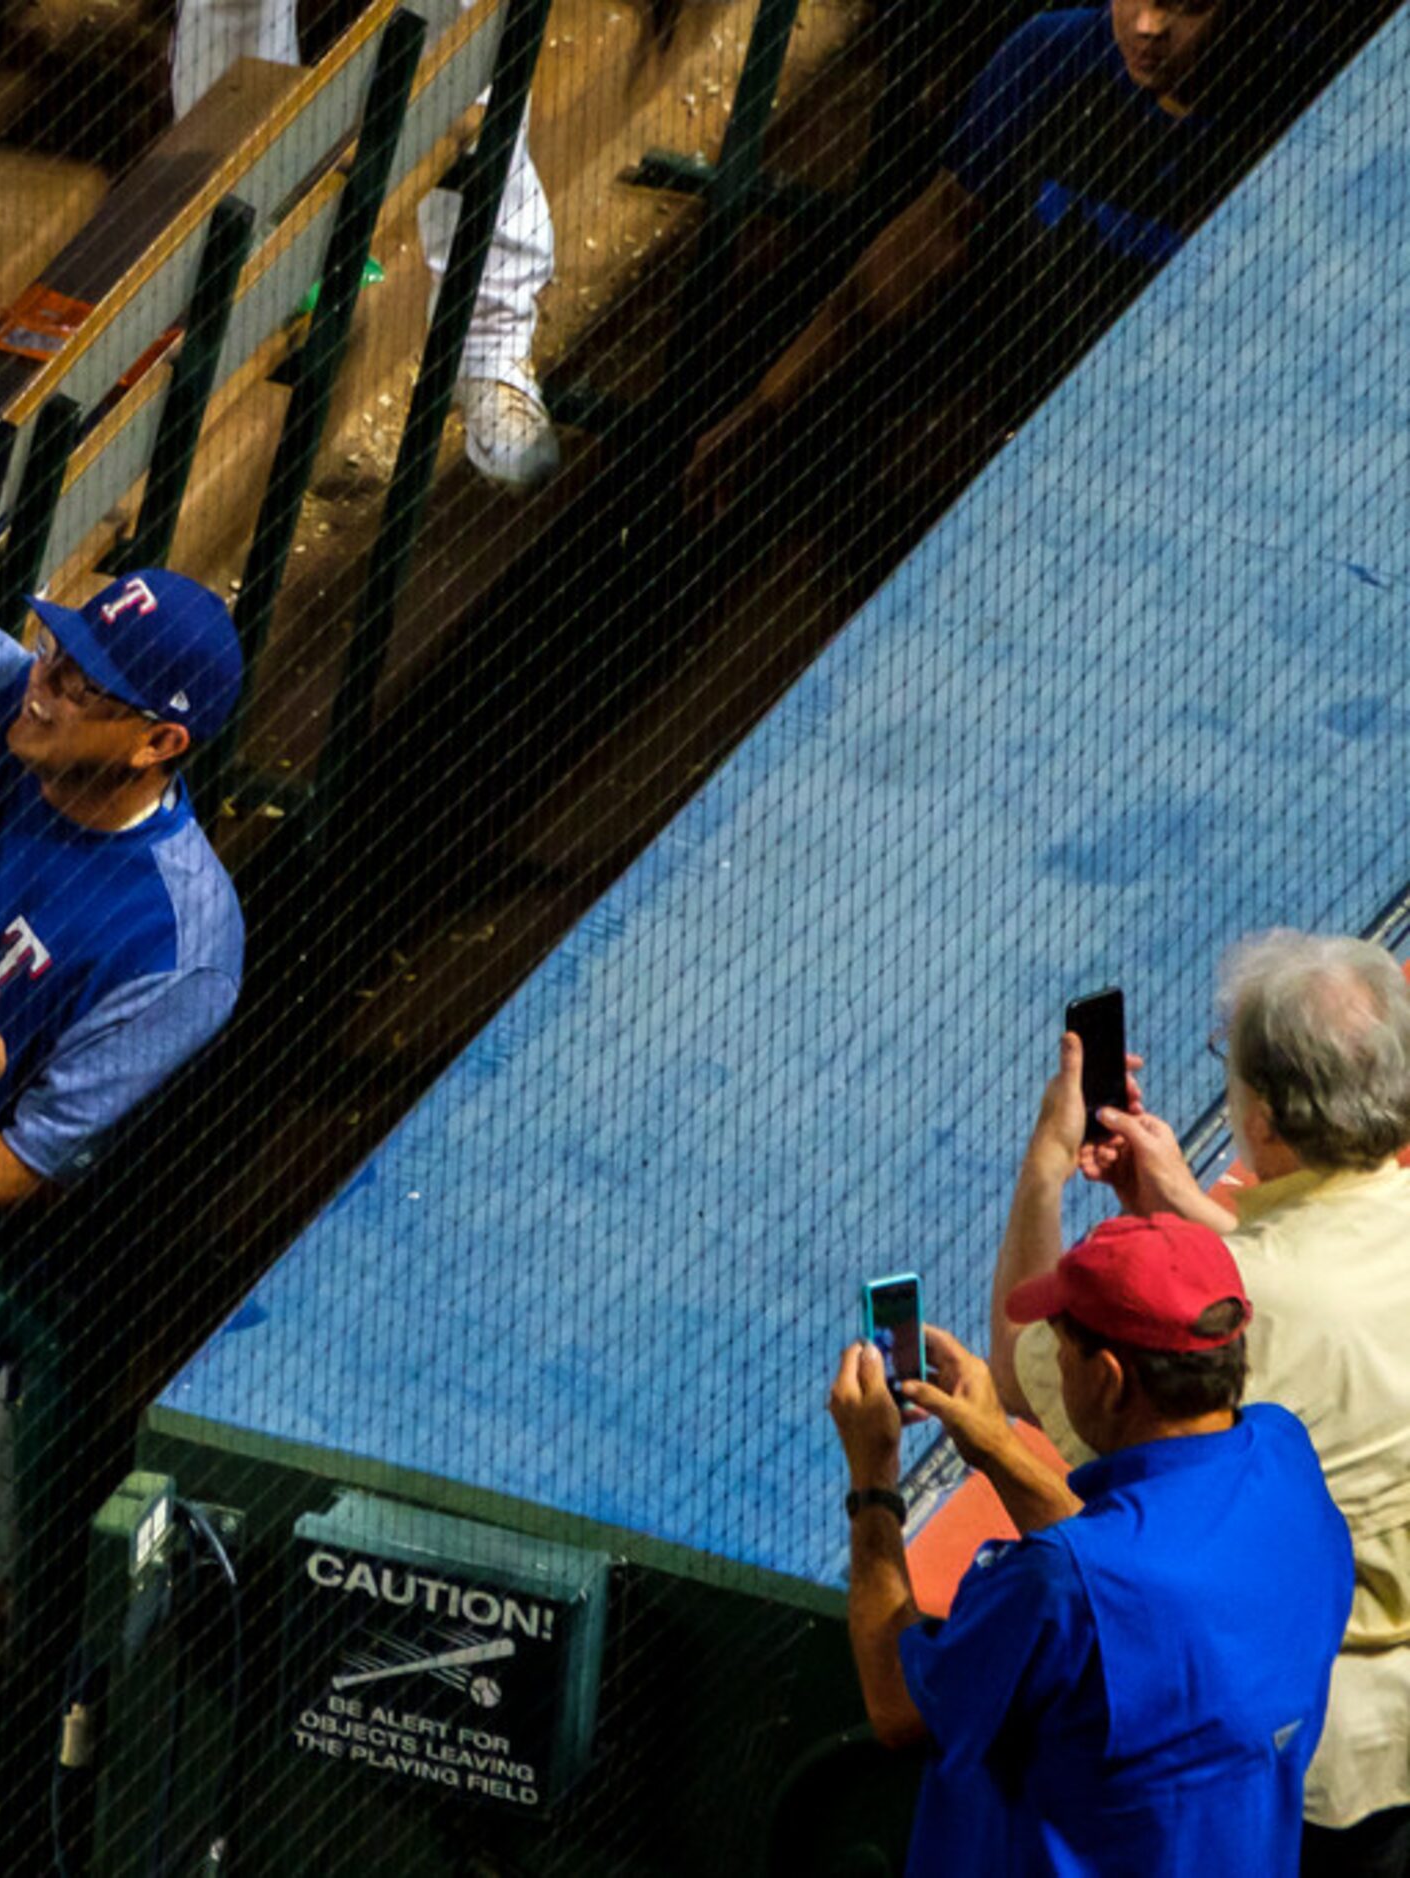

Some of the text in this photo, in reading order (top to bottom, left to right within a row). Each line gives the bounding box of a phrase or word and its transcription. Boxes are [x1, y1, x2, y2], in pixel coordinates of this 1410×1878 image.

[102, 576, 157, 625] T
[306, 1551, 555, 1641] CAUTION!
[299, 1709, 535, 1783] OBJECTS LEAVING
[328, 1695, 510, 1755] BE ALERT FOR
[294, 1731, 539, 1805] THE PLAYING FIELD
